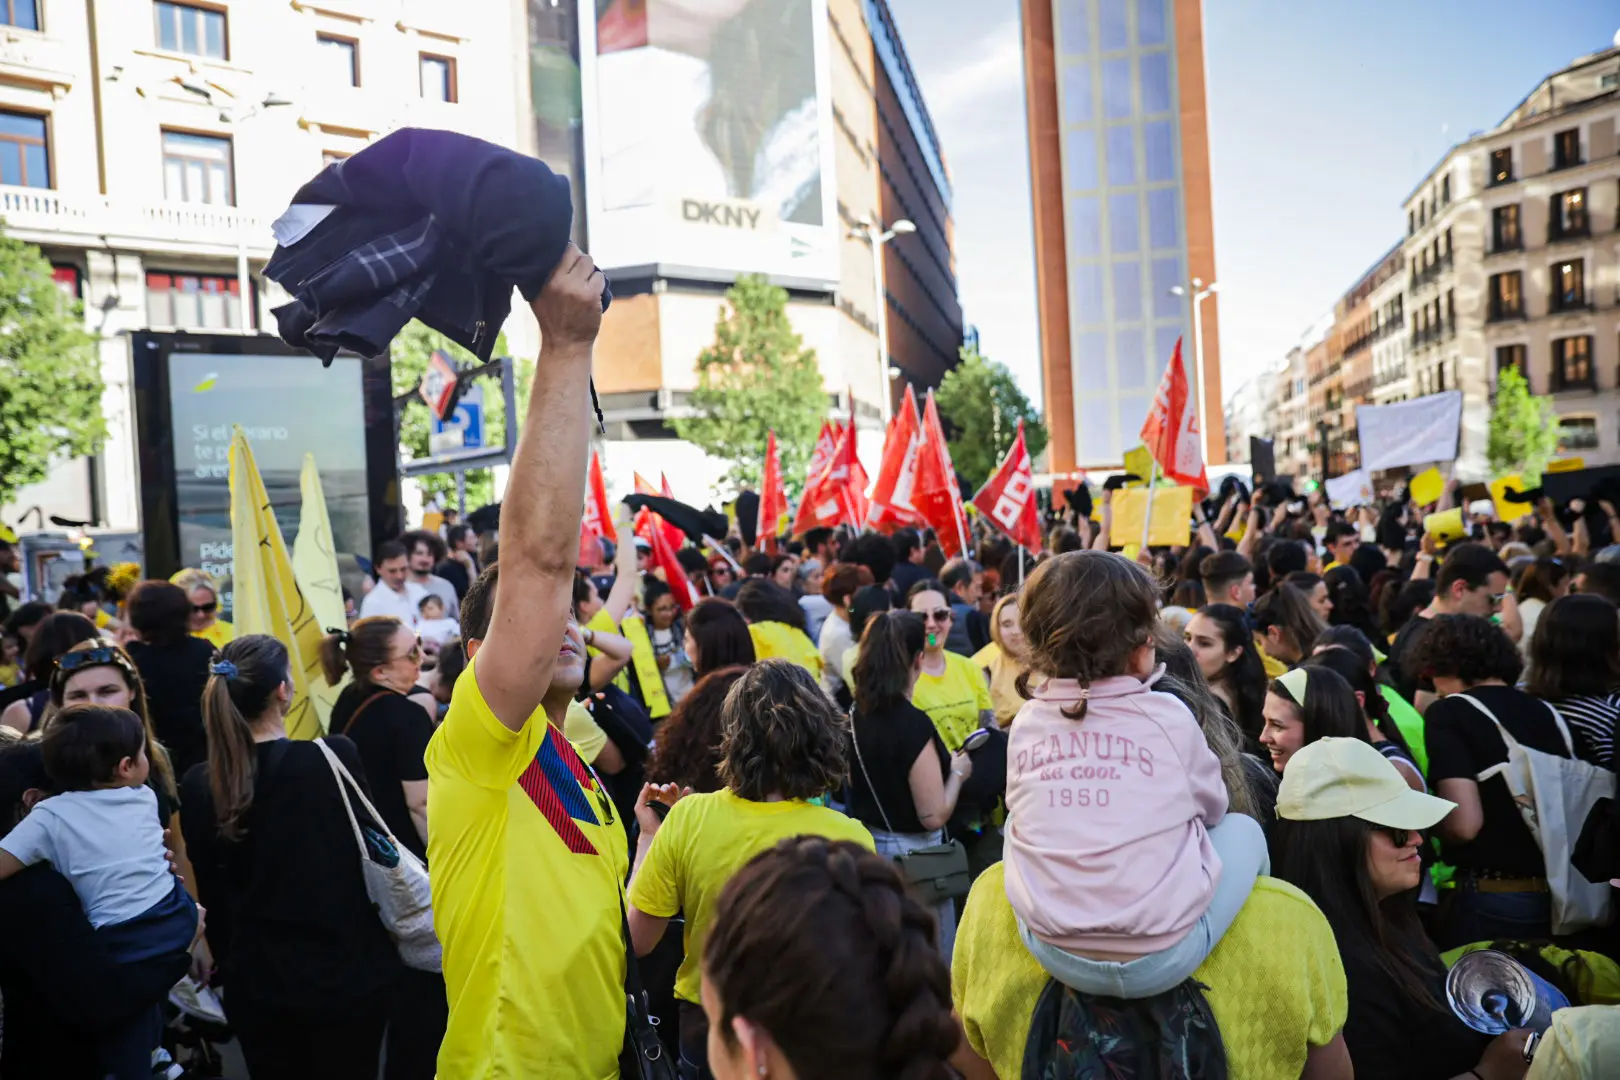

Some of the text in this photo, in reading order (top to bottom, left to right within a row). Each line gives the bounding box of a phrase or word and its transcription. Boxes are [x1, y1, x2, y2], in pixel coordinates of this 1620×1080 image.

[682, 199, 761, 231] DKNY
[1015, 731, 1154, 780] PEANUTS
[1070, 765, 1122, 780] COOL
[1048, 788, 1110, 807] 1950
